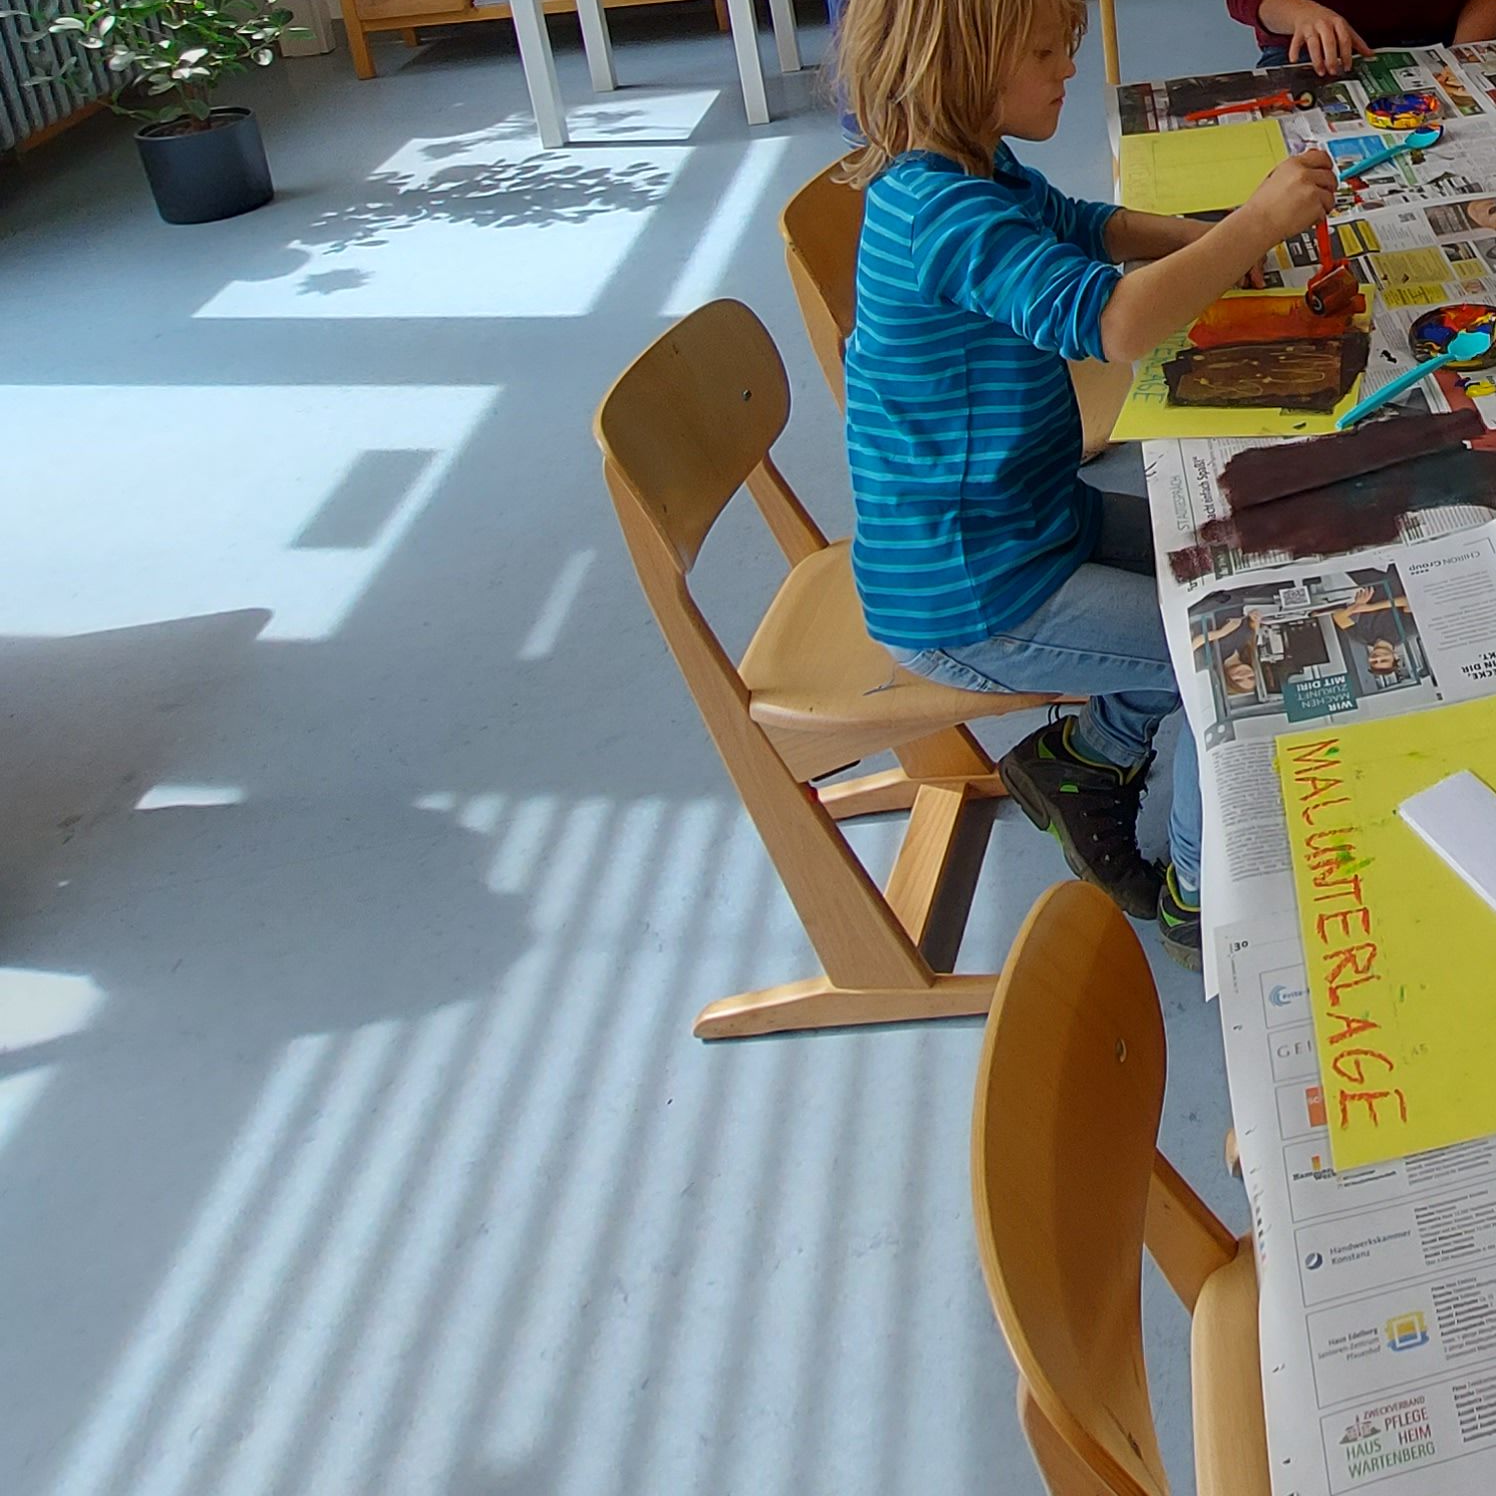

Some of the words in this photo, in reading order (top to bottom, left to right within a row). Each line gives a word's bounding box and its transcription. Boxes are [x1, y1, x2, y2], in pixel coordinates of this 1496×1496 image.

[1322, 674, 1346, 686] MIT
[1460, 662, 1483, 675] DIR
[1327, 699, 1354, 712] WIR
[1286, 738, 1408, 1129] MALUNTERLAGE
[1328, 1228, 1412, 1256] Handwerkskammer
[1383, 1406, 1430, 1432] PFLEGE
[1397, 1422, 1433, 1447] HEIM
[1345, 1437, 1383, 1462] HAUS
[1347, 1440, 1437, 1480] WARTENBERG
